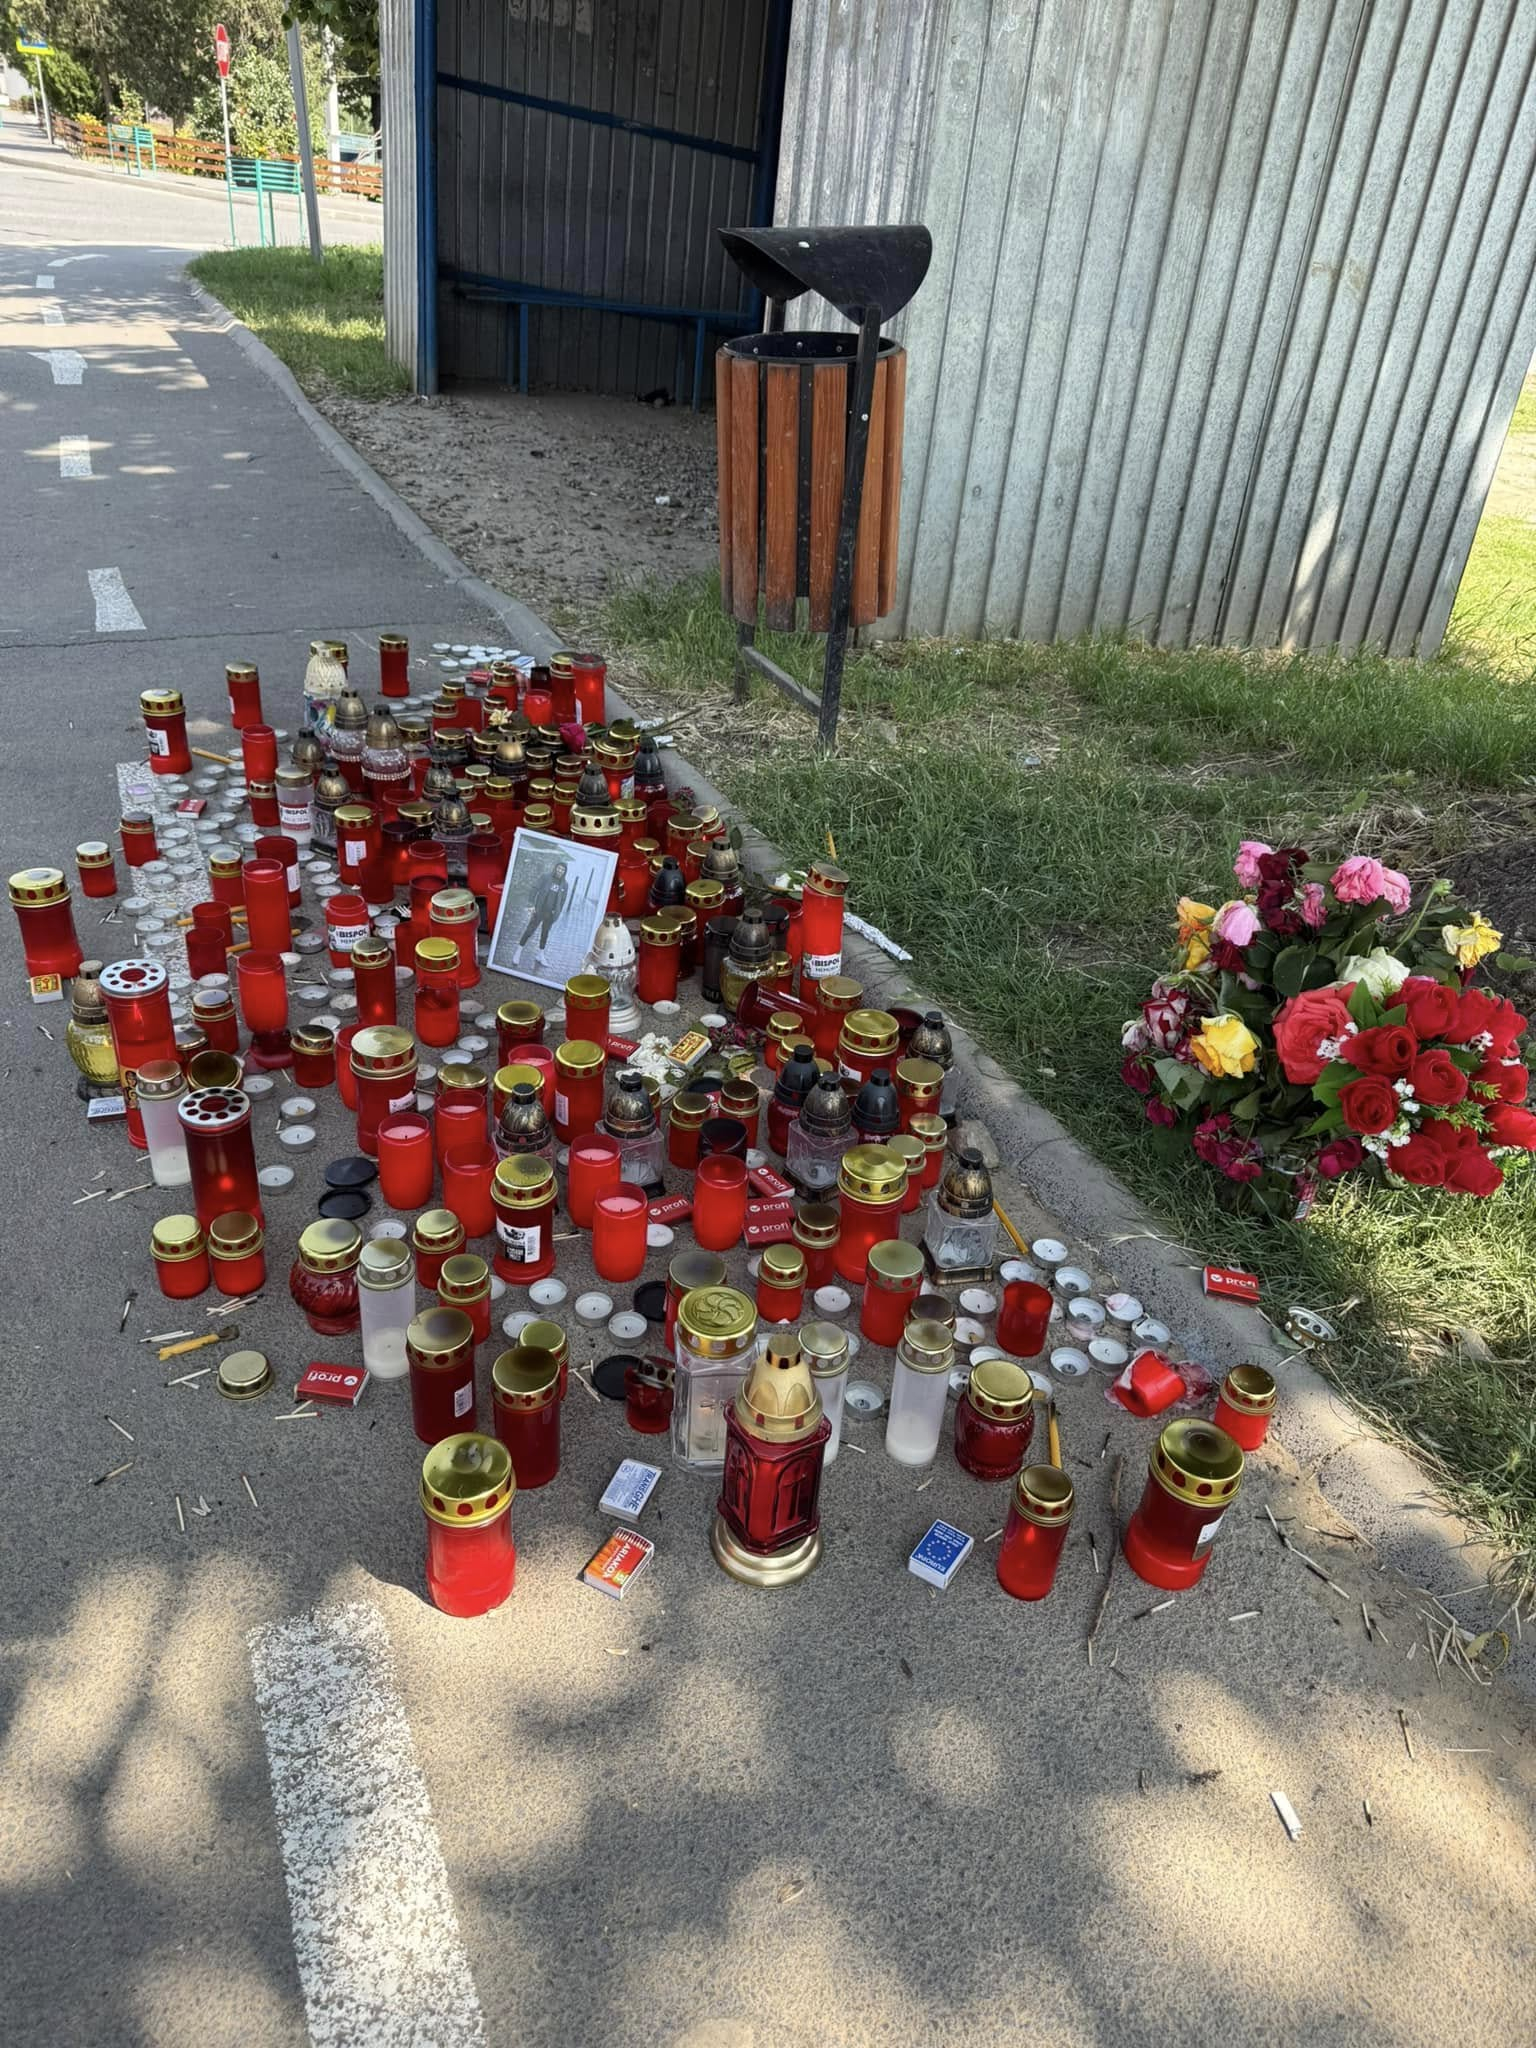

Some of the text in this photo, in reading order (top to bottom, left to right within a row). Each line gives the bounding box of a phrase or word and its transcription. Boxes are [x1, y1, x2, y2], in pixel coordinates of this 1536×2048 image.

[339, 928, 367, 938] BISPOL
[610, 1041, 634, 1051] profi
[766, 1174, 788, 1190] profi
[662, 1199, 689, 1213] profi
[762, 1201, 790, 1211] profi
[761, 1222, 789, 1233] profi
[1225, 1277, 1257, 1288] profi
[306, 1370, 343, 1384] profi
[915, 1553, 946, 1572] EUROPA
